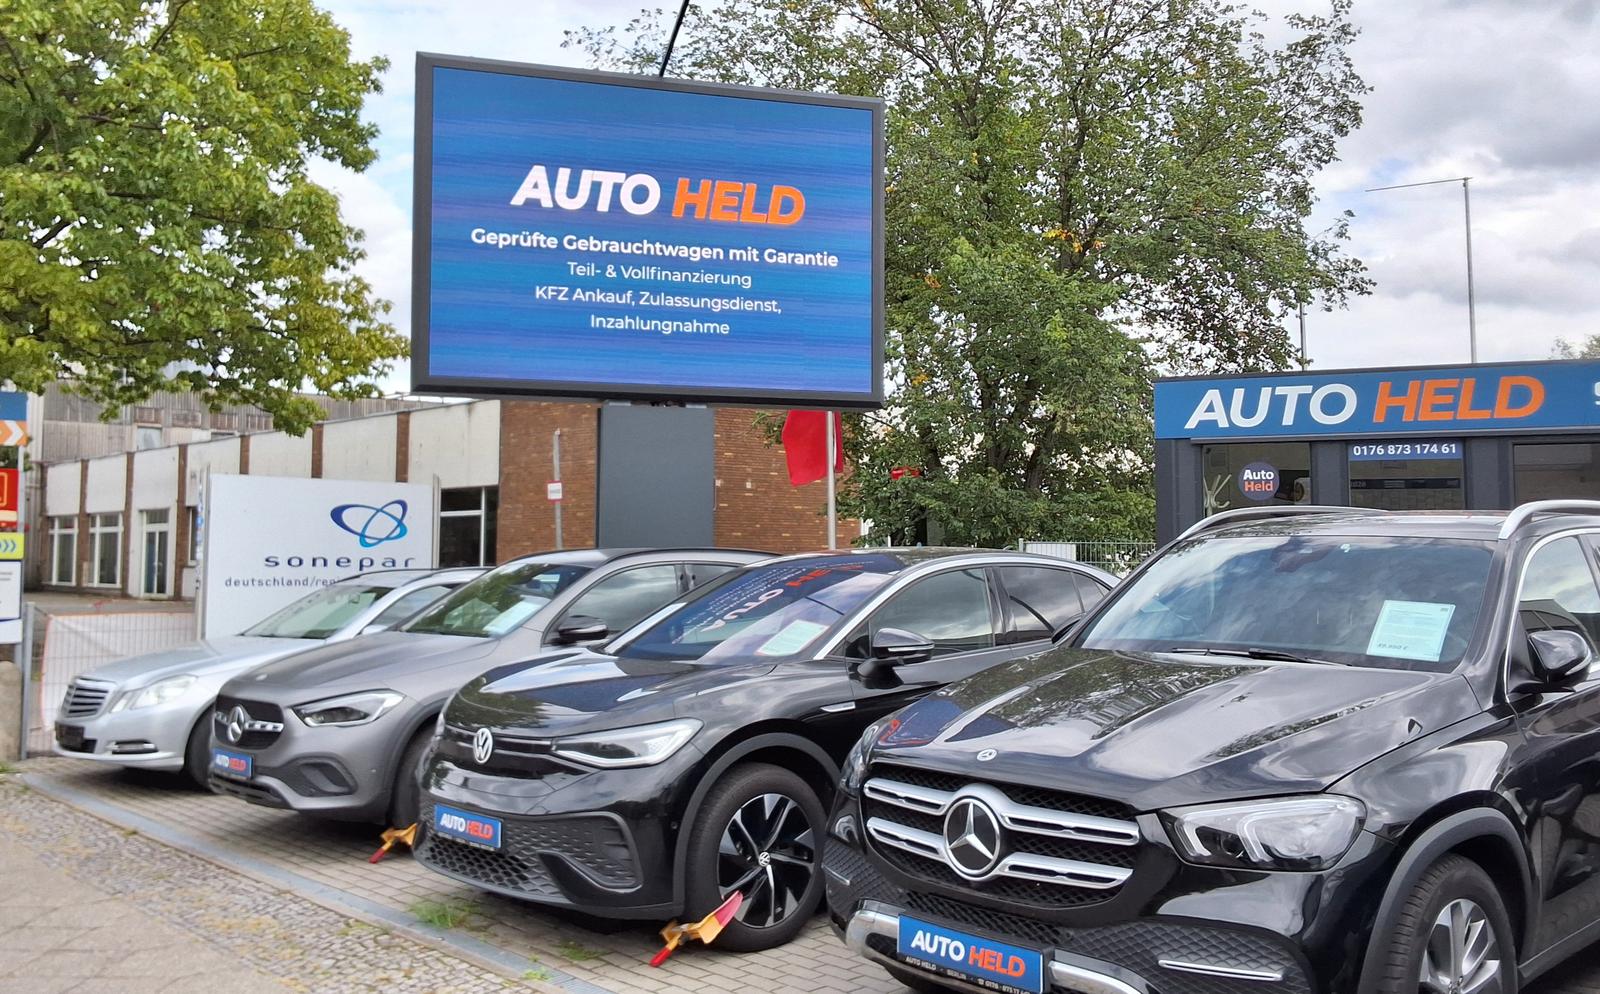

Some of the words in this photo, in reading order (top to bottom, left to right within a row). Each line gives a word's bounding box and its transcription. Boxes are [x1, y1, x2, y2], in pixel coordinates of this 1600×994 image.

[510, 165, 661, 215] AUTO
[671, 178, 806, 225] HELD
[471, 228, 558, 251] Geprüfte
[563, 234, 724, 262] Gebrauchtwagen
[729, 248, 759, 262] mit
[764, 249, 839, 267] Garantie
[567, 262, 601, 277] Teil-
[605, 265, 617, 278] &
[621, 265, 752, 289] Vollfinanzierung
[535, 286, 569, 301] KFZ
[572, 289, 635, 306] Ankauf,
[639, 292, 782, 314] Zulassungsdienst,
[590, 314, 730, 335] Inzahlungnahme
[1184, 383, 1358, 429] AUTO
[1373, 375, 1546, 424] HELD
[1353, 445, 1385, 456] 0176
[1387, 444, 1411, 455] 873
[1414, 443, 1438, 454] 174
[1441, 443, 1456, 453] 61
[1243, 469, 1274, 480] Auto
[1244, 480, 1274, 492] Held
[264, 555, 416, 571] sonepar
[440, 813, 466, 832] AUTO
[467, 820, 494, 840] HELD
[911, 930, 965, 961] AUTO
[968, 945, 1025, 977] HELD
